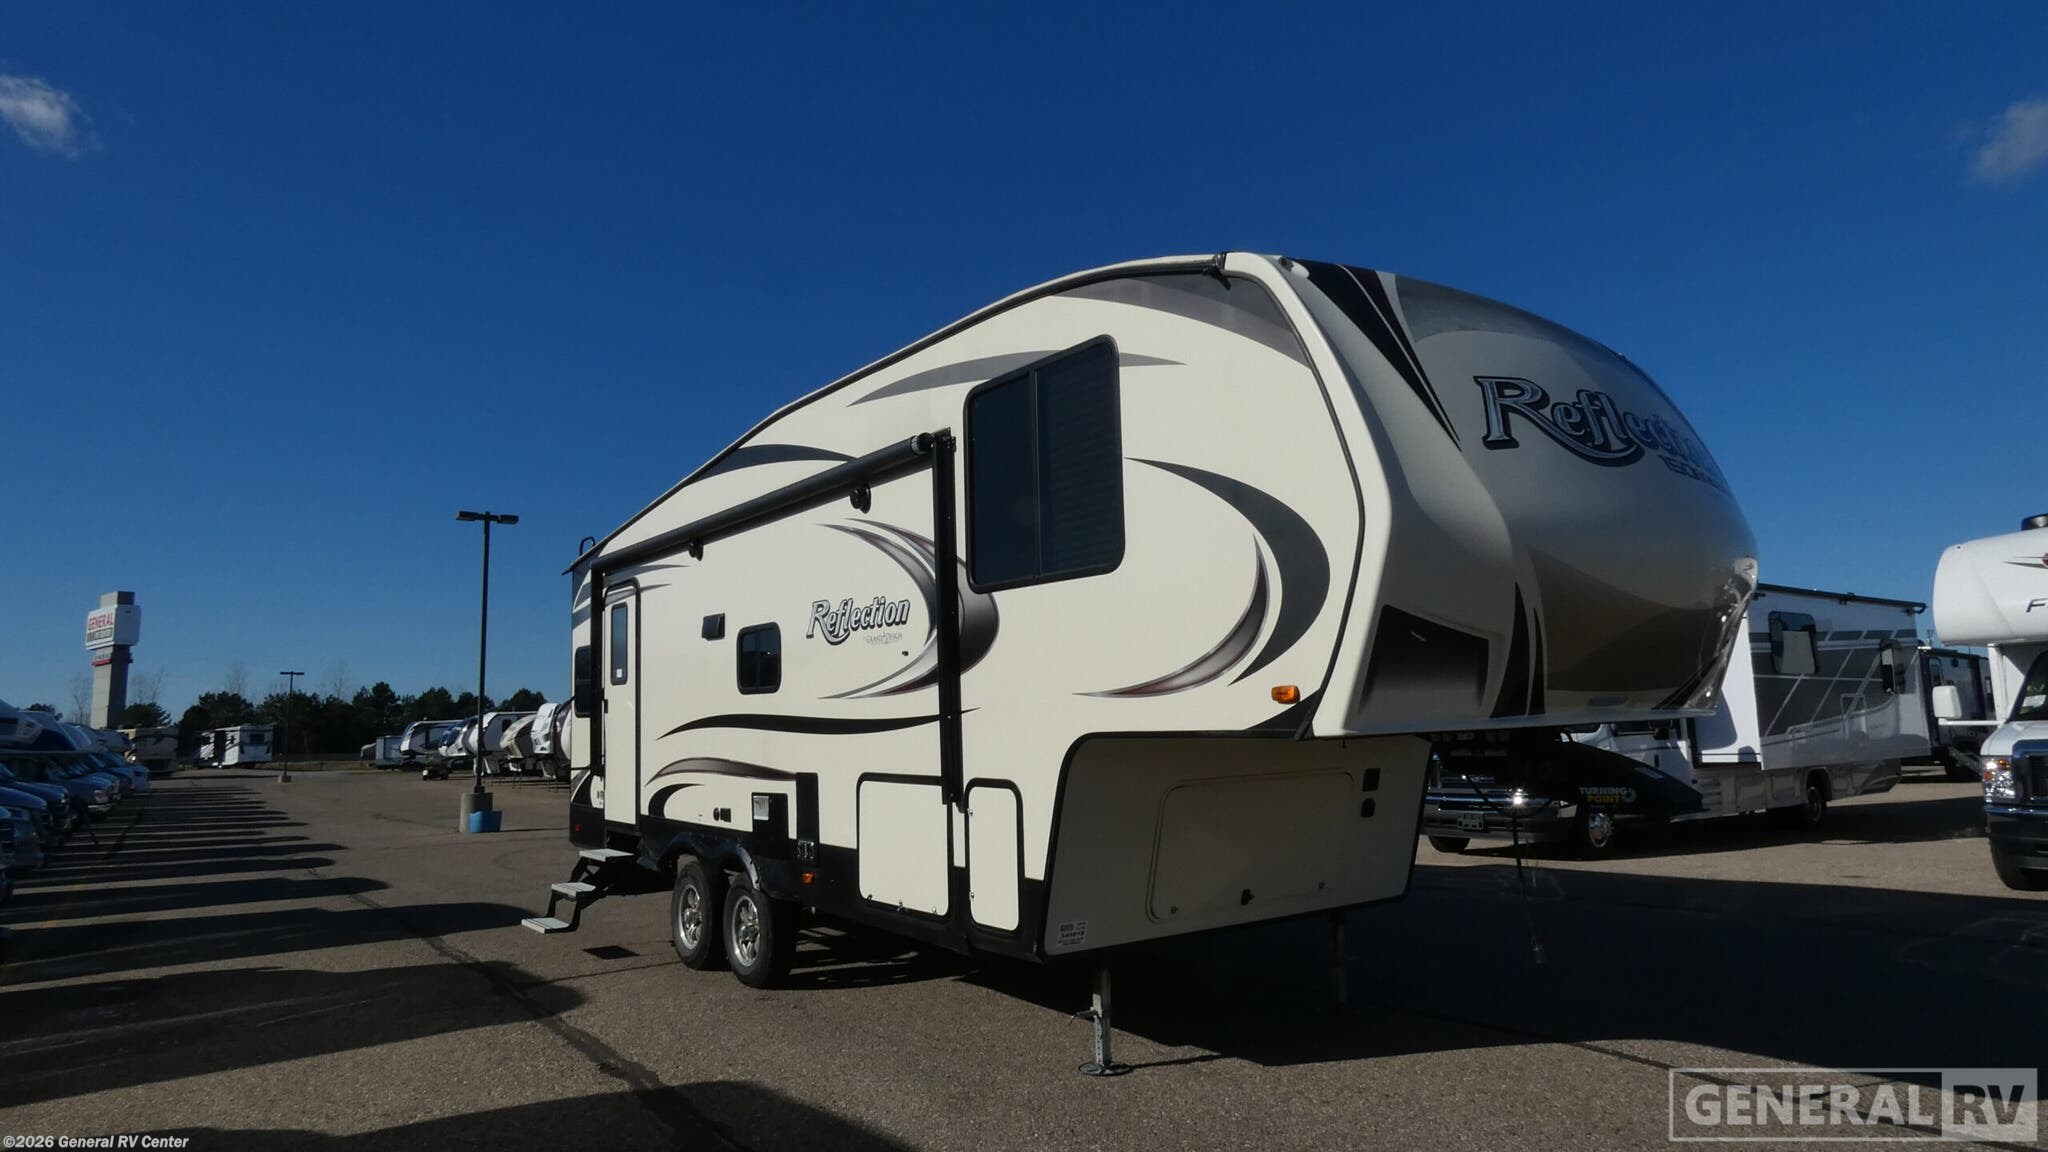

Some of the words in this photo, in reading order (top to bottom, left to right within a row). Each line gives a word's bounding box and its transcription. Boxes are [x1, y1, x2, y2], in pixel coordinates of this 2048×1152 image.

[1472, 375, 1716, 468] Reflecti
[88, 612, 113, 631] GENERAL
[806, 596, 910, 645] Reflection
[1579, 786, 1628, 795] TURNING
[1587, 795, 1621, 803] POINT
